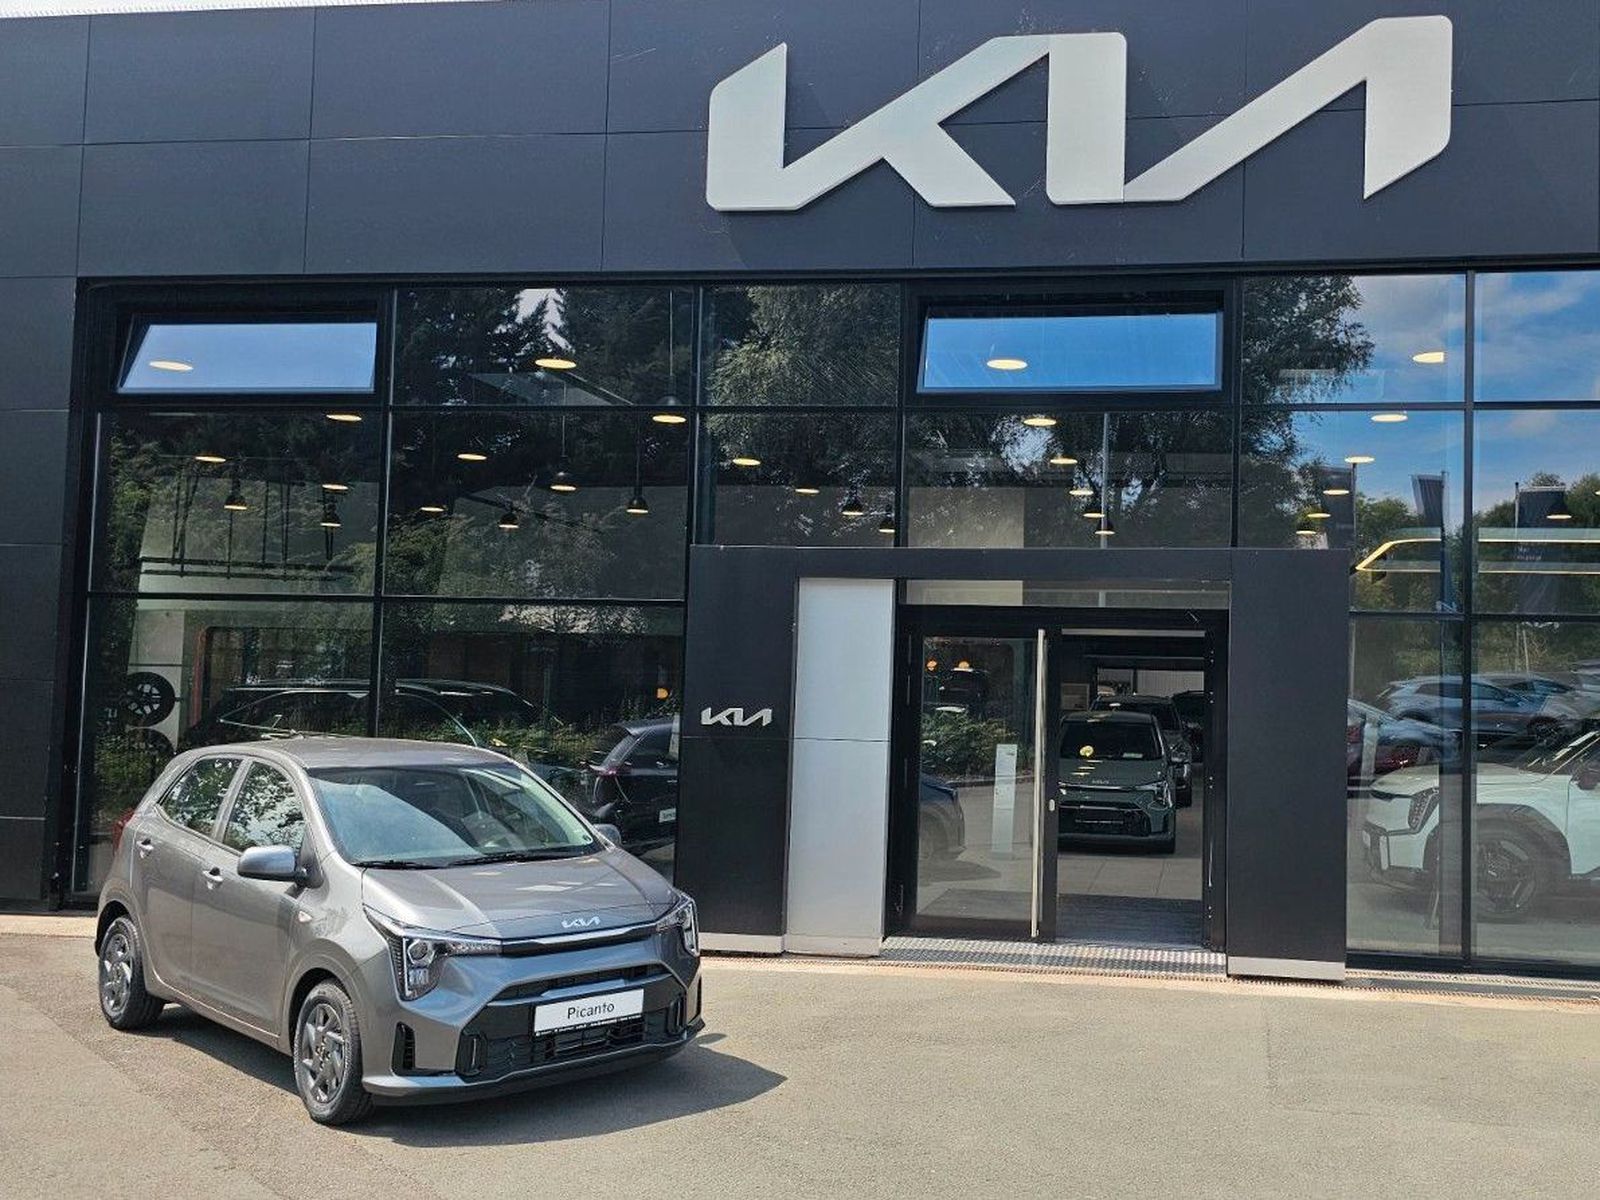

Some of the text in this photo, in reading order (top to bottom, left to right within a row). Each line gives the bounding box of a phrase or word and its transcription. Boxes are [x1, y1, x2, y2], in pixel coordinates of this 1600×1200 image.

[706, 15, 1452, 211] KIA
[701, 707, 773, 726] KIA
[567, 1003, 615, 1019] Picanto
